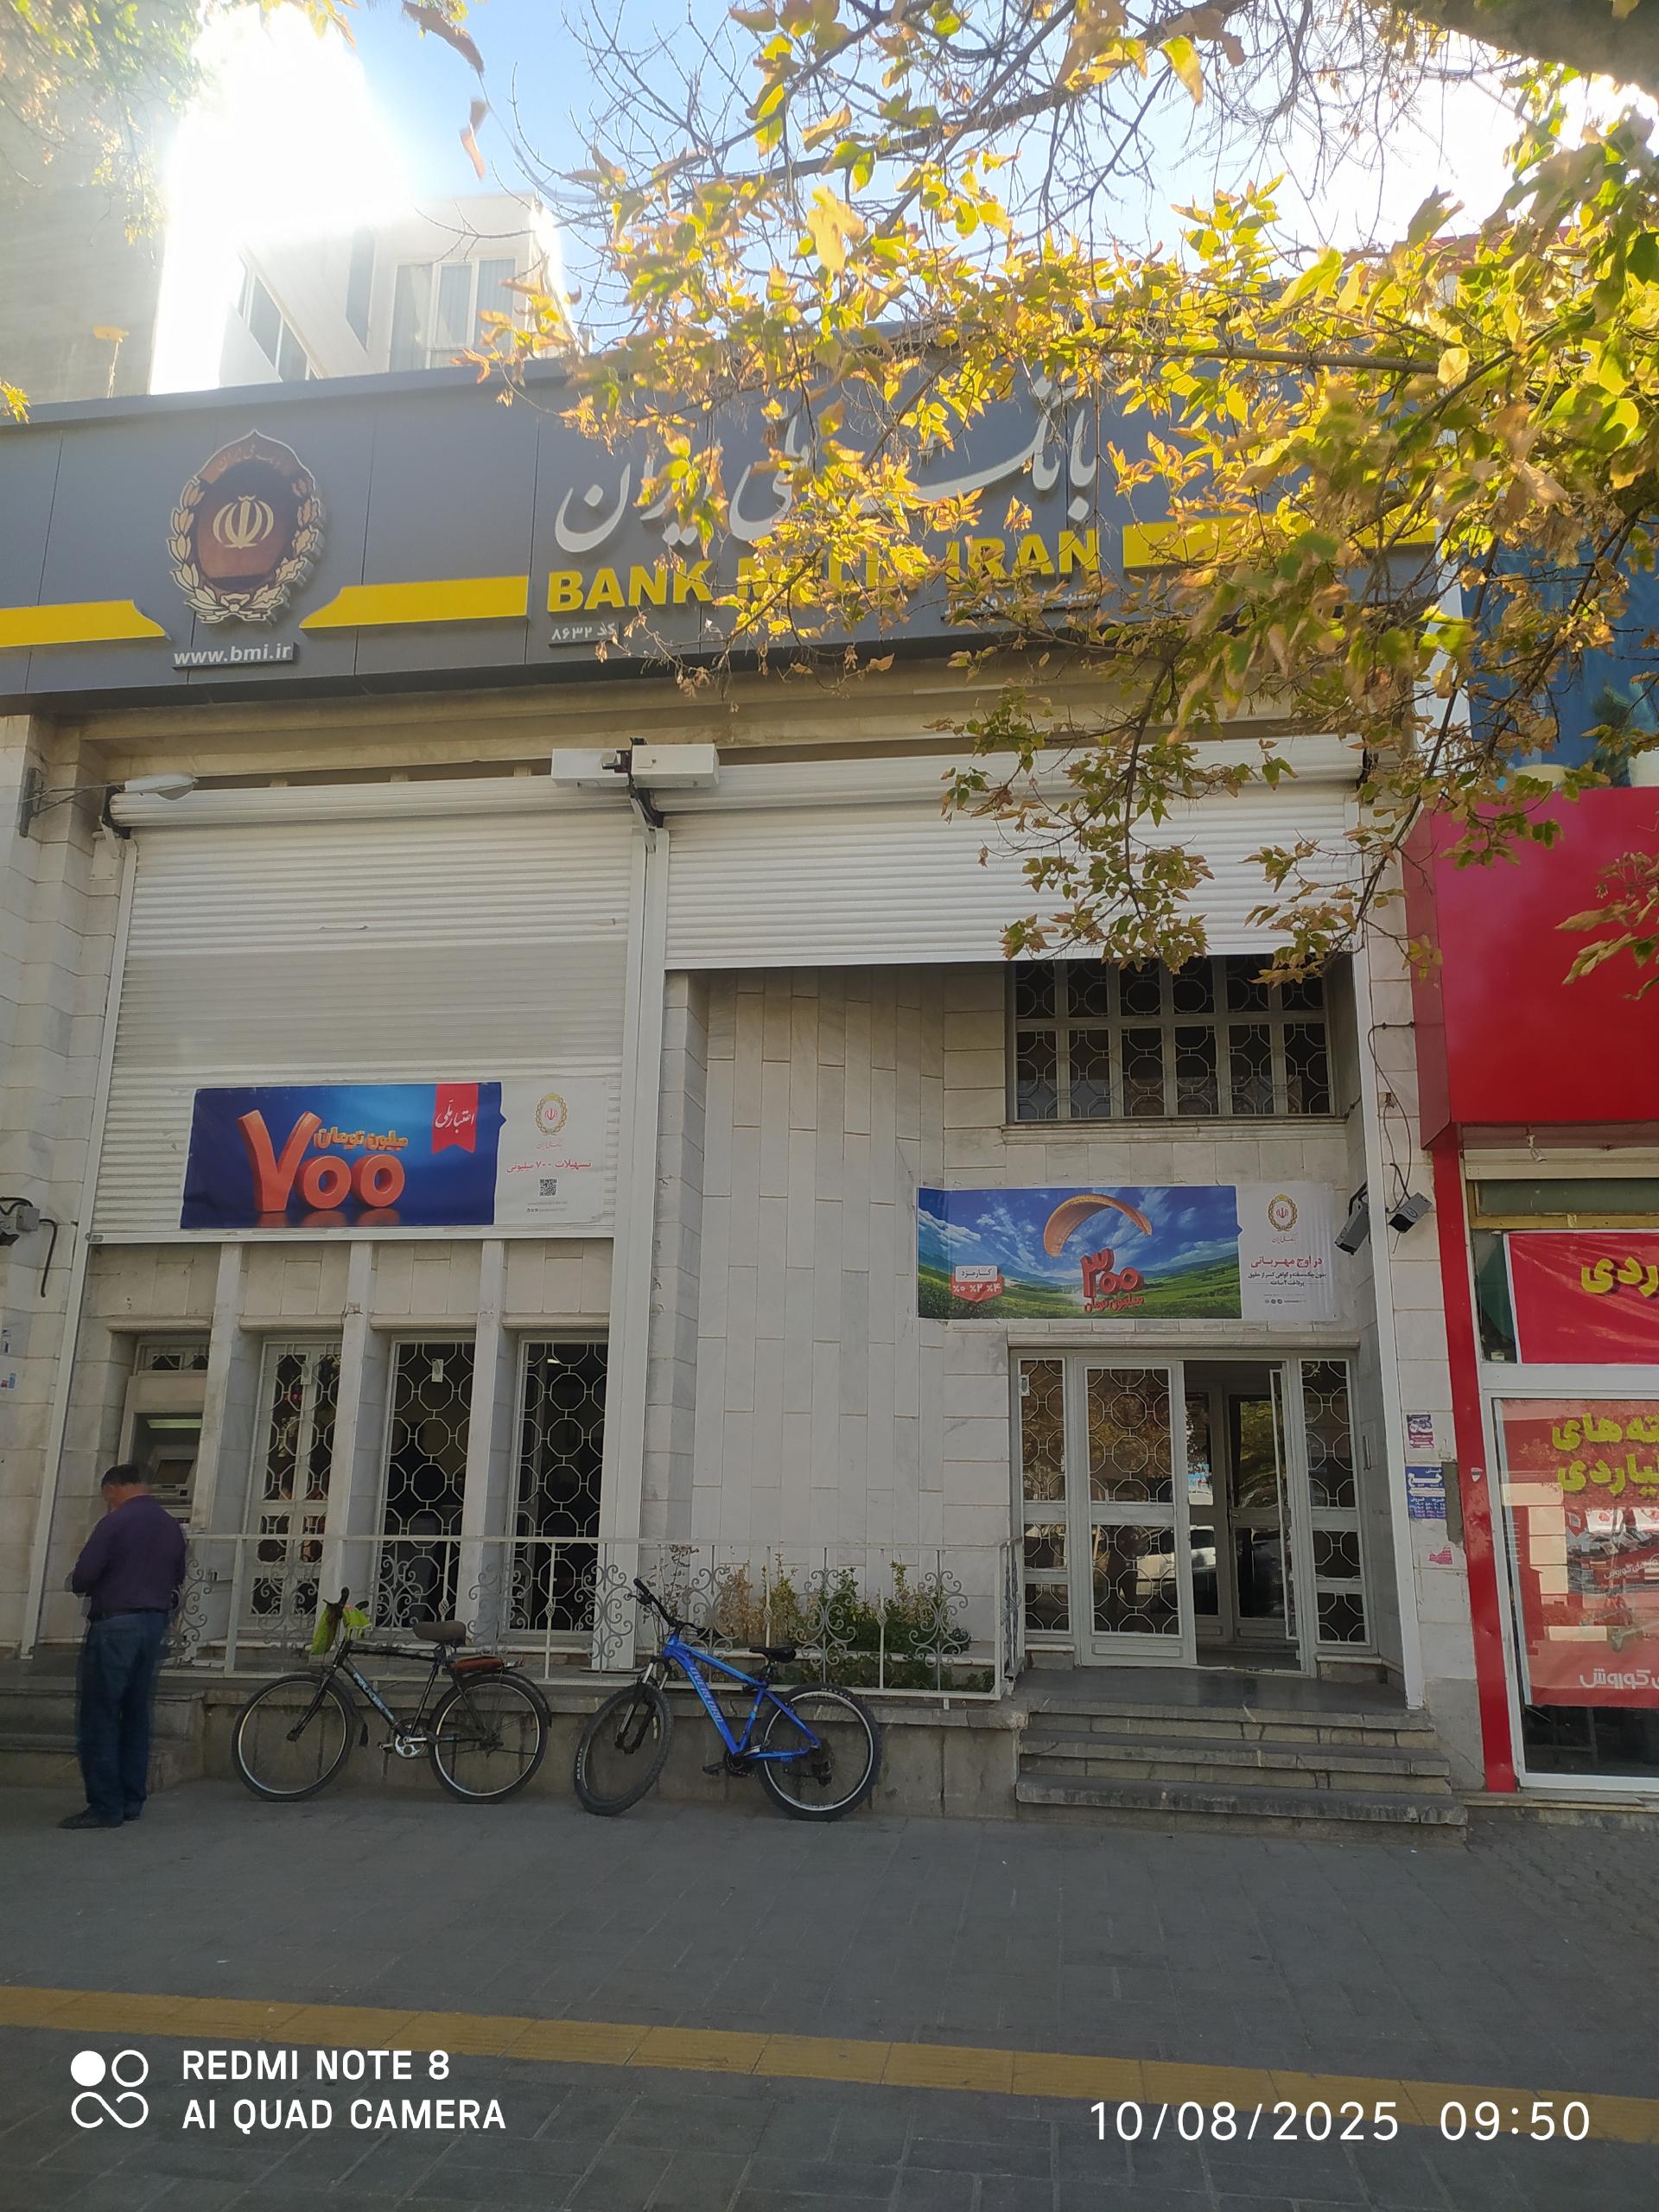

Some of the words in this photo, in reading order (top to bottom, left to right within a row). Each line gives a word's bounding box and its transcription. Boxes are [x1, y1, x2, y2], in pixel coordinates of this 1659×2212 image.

[547, 558, 714, 613] BANK
[946, 528, 1099, 584] IRAN
[551, 626, 593, 640] ۸۶۳۲
[174, 643, 291, 665] www.bmi.ir
[444, 1109, 474, 1134] اعتبار
[314, 1126, 365, 1150] تومان
[365, 1129, 409, 1151] میلیون
[237, 1109, 405, 1212] ۷۰۰
[555, 1159, 592, 1171] تسهیلات
[1250, 1255, 1295, 1268] مهربانی
[1296, 1255, 1312, 1268] اوج
[1313, 1257, 1323, 1268] در
[961, 1268, 992, 1278] کارمزد
[1080, 1248, 1145, 1298] ۳۰۰
